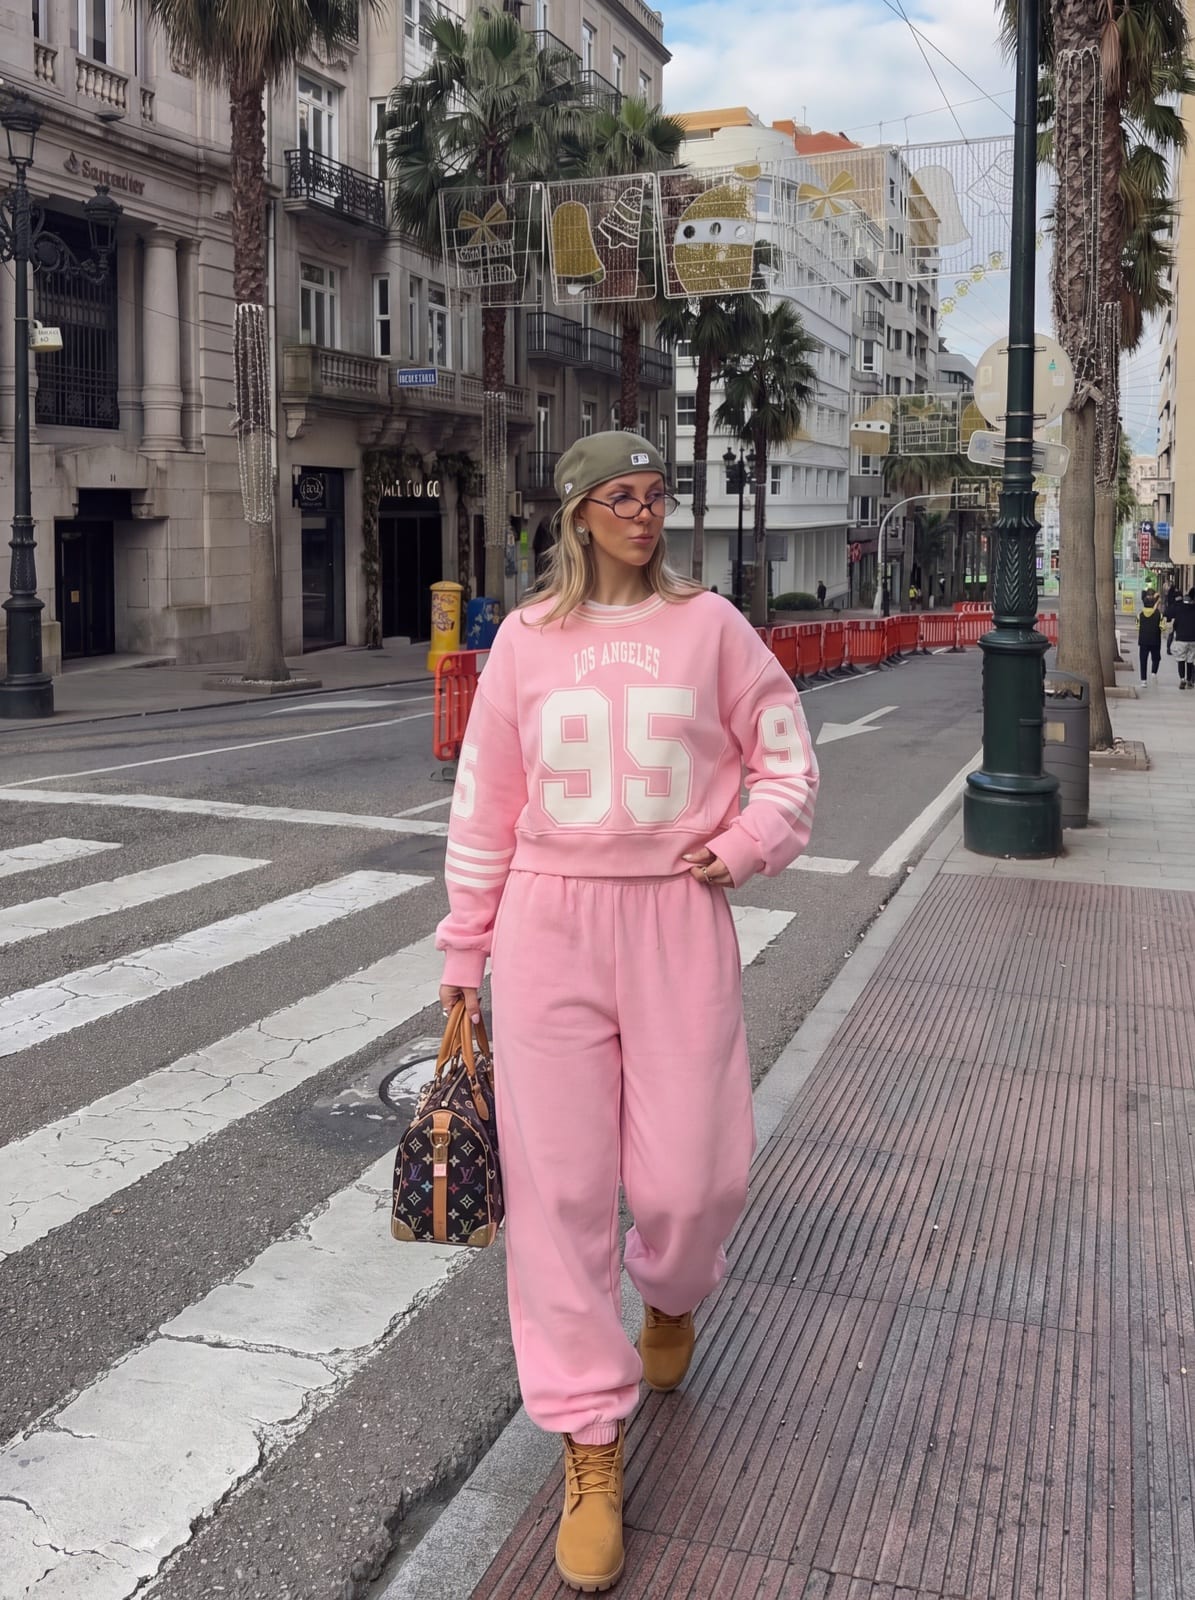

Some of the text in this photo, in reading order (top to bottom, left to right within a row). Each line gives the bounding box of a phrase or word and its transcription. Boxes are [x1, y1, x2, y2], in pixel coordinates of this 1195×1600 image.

[573, 641, 661, 684] LOS ANGELES
[539, 684, 697, 827] 95
[760, 704, 819, 775] 9
[452, 742, 480, 820] 5
